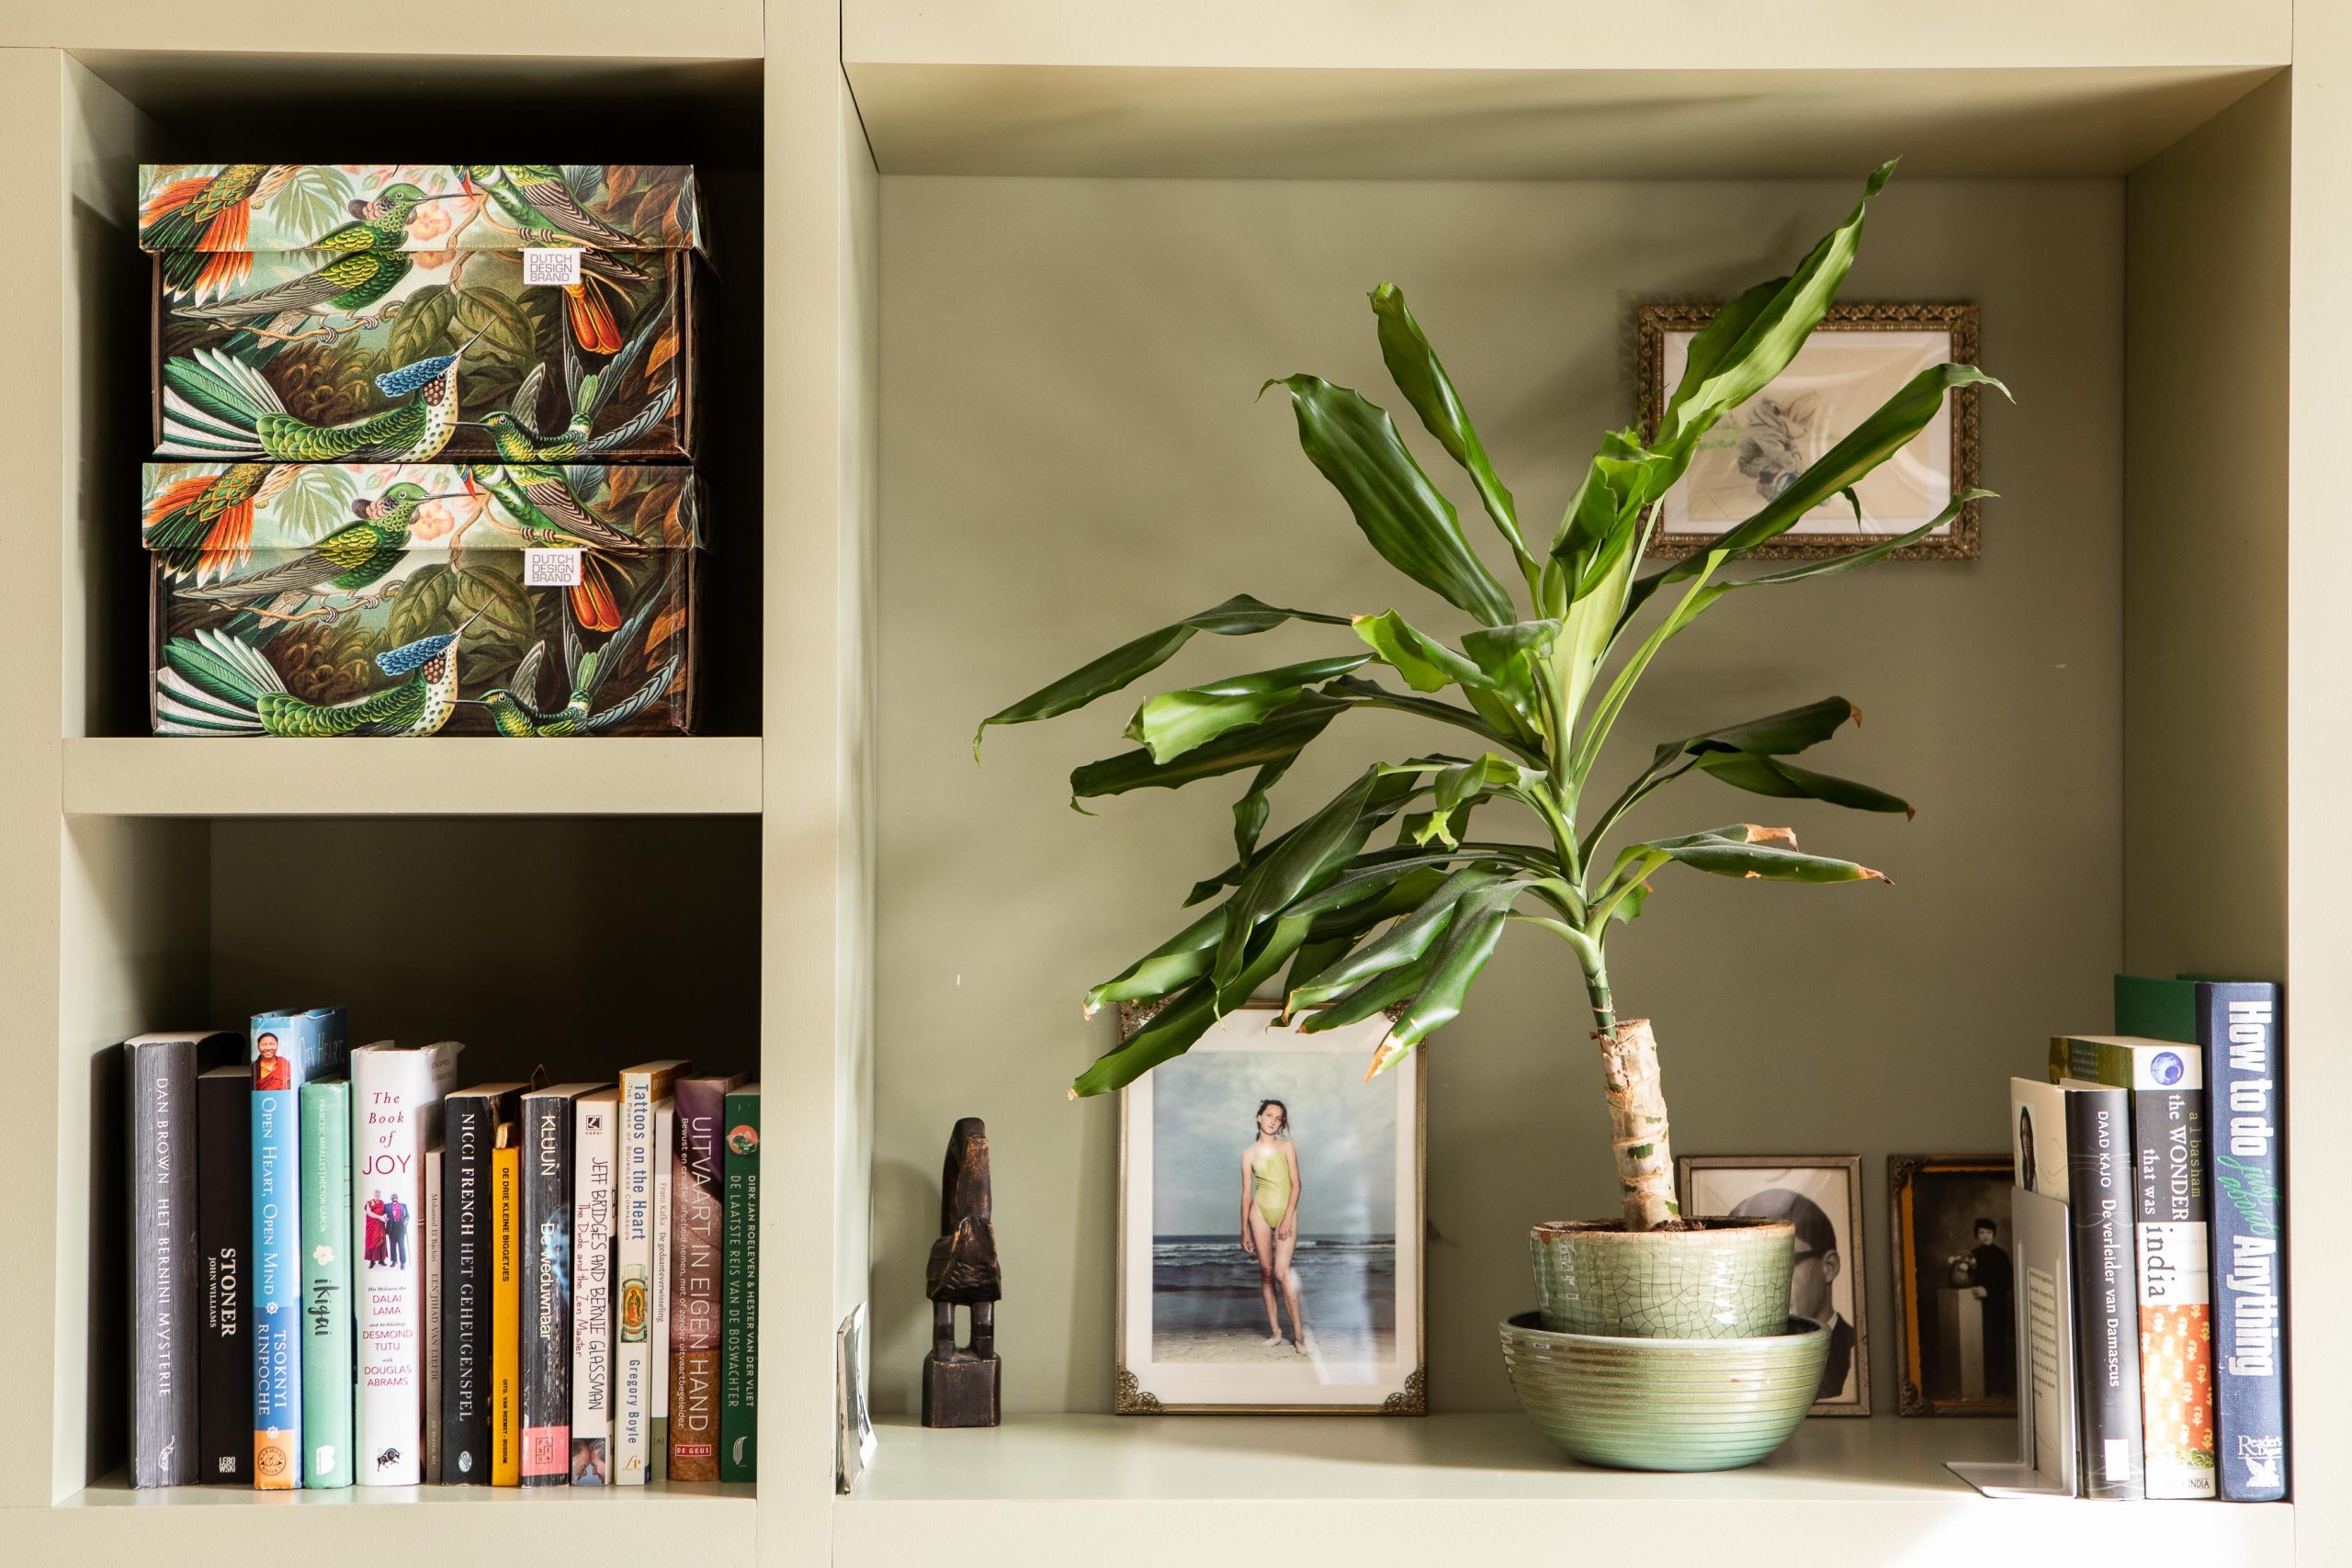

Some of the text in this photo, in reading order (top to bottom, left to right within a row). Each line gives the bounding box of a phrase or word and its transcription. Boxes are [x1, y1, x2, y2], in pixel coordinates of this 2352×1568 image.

[530, 254, 572, 264] DUTCH
[530, 264, 572, 273] DESIGN
[530, 273, 570, 282] BRAND
[532, 554, 574, 564] DUTCH
[532, 564, 574, 573] DESIGN
[532, 573, 571, 582] BRAND
[2229, 1001, 2274, 1156] How to do
[373, 1092, 400, 1103] The
[368, 1111, 404, 1123] Book
[2188, 1111, 2199, 1122] a
[379, 1131, 396, 1148] of
[541, 1115, 556, 1176] KLUUN
[627, 1133, 631, 1142] OF
[681, 1118, 689, 1151] Bewust
[318, 1137, 326, 1171] MIRALLES
[362, 1154, 412, 1175] JOY
[632, 1084, 649, 1240] Tattoos on the Heart
[681, 1154, 687, 1164] en
[2168, 1094, 2189, 1220] the WONDER
[2190, 1139, 2202, 1198] basham
[503, 1168, 509, 1179] DE
[681, 1167, 689, 1203] creatief
[748, 1175, 756, 1200] DIRK
[2143, 1148, 2160, 1215] that was
[262, 1098, 278, 1295] OPEN HEART, OPEN MIND
[660, 1205, 668, 1225] Kafka
[680, 1205, 688, 1243] afscheid
[156, 1078, 171, 1396] DAN BROWN HET BERNINI MYSTERIE
[659, 1233, 666, 1241] De
[747, 1224, 755, 1278] ROELEVEN
[2098, 1111, 2122, 1387] DAAD KAJO De verleider van Damascus
[208, 1257, 216, 1280] JOHN
[459, 1113, 475, 1421] NICCI FRENCH HET GEHEUGENSPEL
[689, 1117, 711, 1431] UITVAART IN EIGEN HAND
[2146, 1225, 2176, 1298] india
[220, 1247, 236, 1337] STONER
[540, 1223, 555, 1340] De weduwnaar
[575, 1202, 590, 1358] The Dude and the Zen Master
[588, 1157, 608, 1410] JEFF BRIDGES AND BERNIE GLASSMAN
[656, 1243, 667, 1323] gedaanteverwisseling
[728, 1176, 741, 1407] DE LAATSTE REIS VAN DE BOSWACHTER
[308, 1279, 340, 1336] ikigai
[372, 1294, 401, 1303] DALAI
[373, 1306, 401, 1315] LAMA
[430, 1294, 439, 1323] JIHAD
[679, 1298, 687, 1310] of
[746, 1291, 754, 1329] HESTER
[2226, 1235, 2278, 1376] Anything
[362, 1330, 413, 1339] DESMOND
[431, 1326, 439, 1345] VAN
[678, 1311, 687, 1341] zonder
[375, 1342, 401, 1351] TUTU
[746, 1332, 754, 1353] VAN
[258, 1324, 270, 1416] RINPOCHE
[274, 1330, 287, 1408] TSOKNYI
[364, 1365, 412, 1375] DOUGLAS
[746, 1357, 754, 1377] DER
[367, 1378, 409, 1387] ABRAMS
[676, 1343, 687, 1428] uitvaartbegeleider
[745, 1379, 753, 1407] VLIET
[627, 1359, 640, 1444] Gregory Boyle
